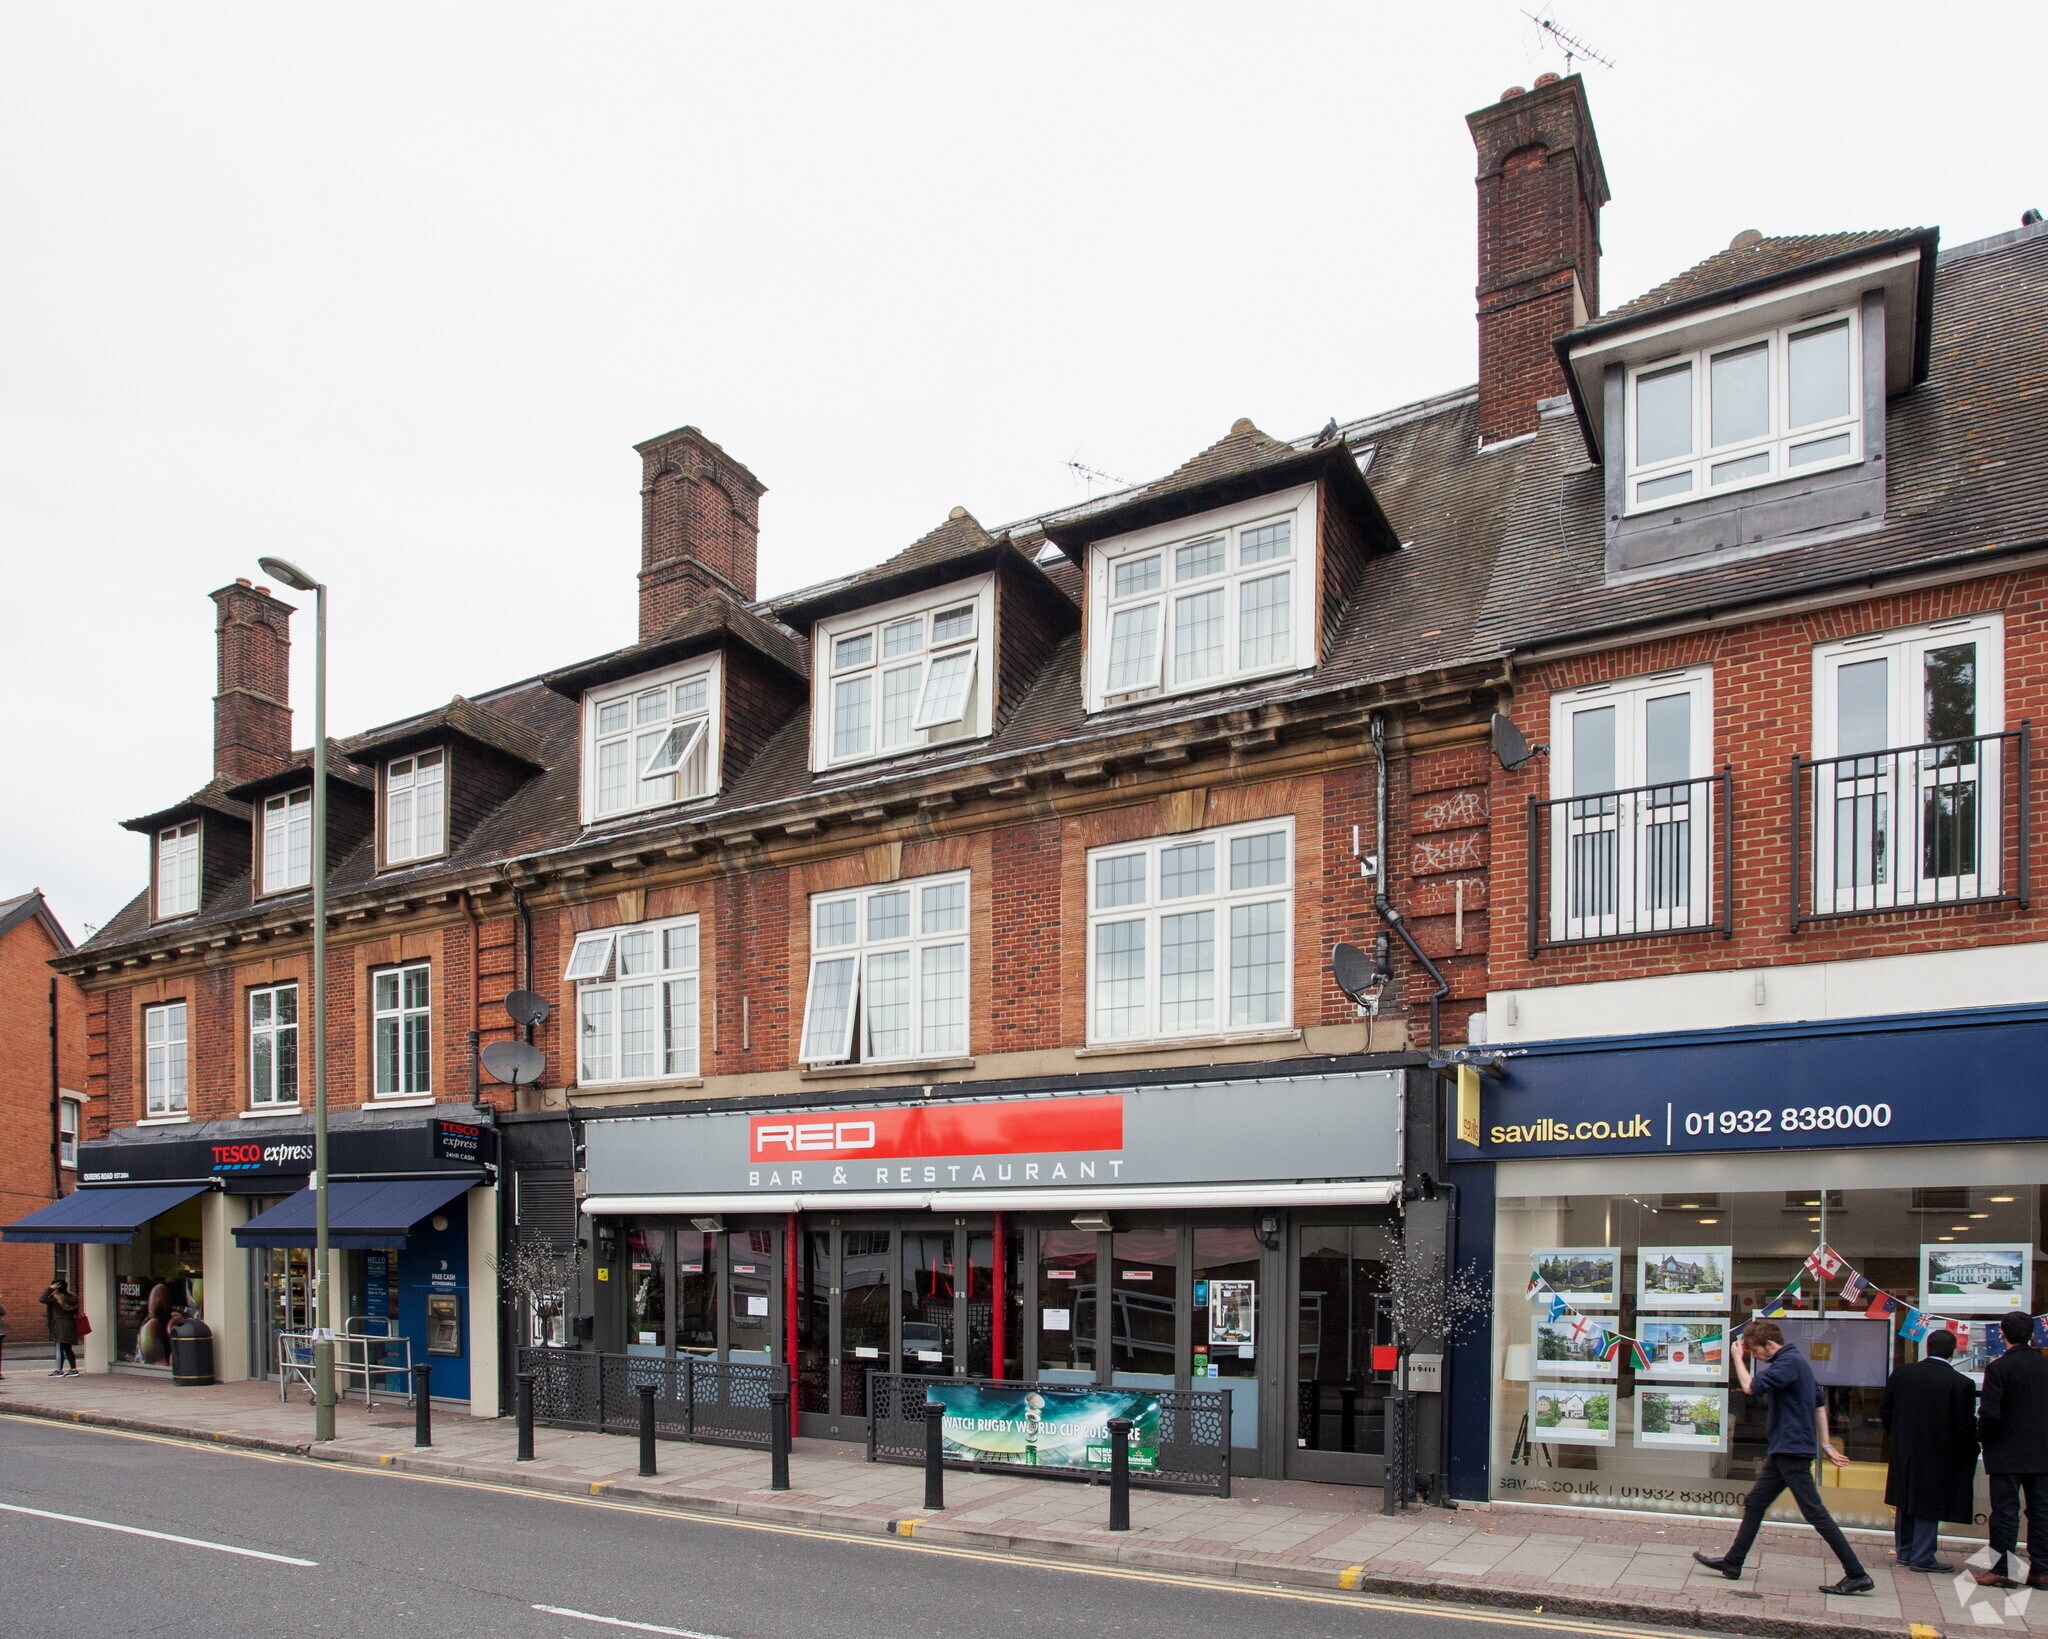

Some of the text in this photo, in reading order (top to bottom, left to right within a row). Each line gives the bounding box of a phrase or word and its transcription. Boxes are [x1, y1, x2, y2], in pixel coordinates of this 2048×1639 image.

[440, 1121, 480, 1137] TESCO
[1490, 1103, 1891, 1143] savills.co.uk 01932 838000
[443, 1137, 478, 1149] express
[757, 1121, 874, 1152] RED
[212, 1143, 313, 1166] TESCO express
[460, 1153, 475, 1161] CASH
[749, 1160, 1124, 1186] BAR & RESTAURANT
[367, 1256, 386, 1265] HELLO
[120, 1283, 140, 1297] FRESH
[942, 1416, 975, 1431] WATCH
[977, 1418, 1013, 1433] RUGBY
[1060, 1423, 1082, 1437] CUP
[1084, 1425, 1108, 1439] 2015
